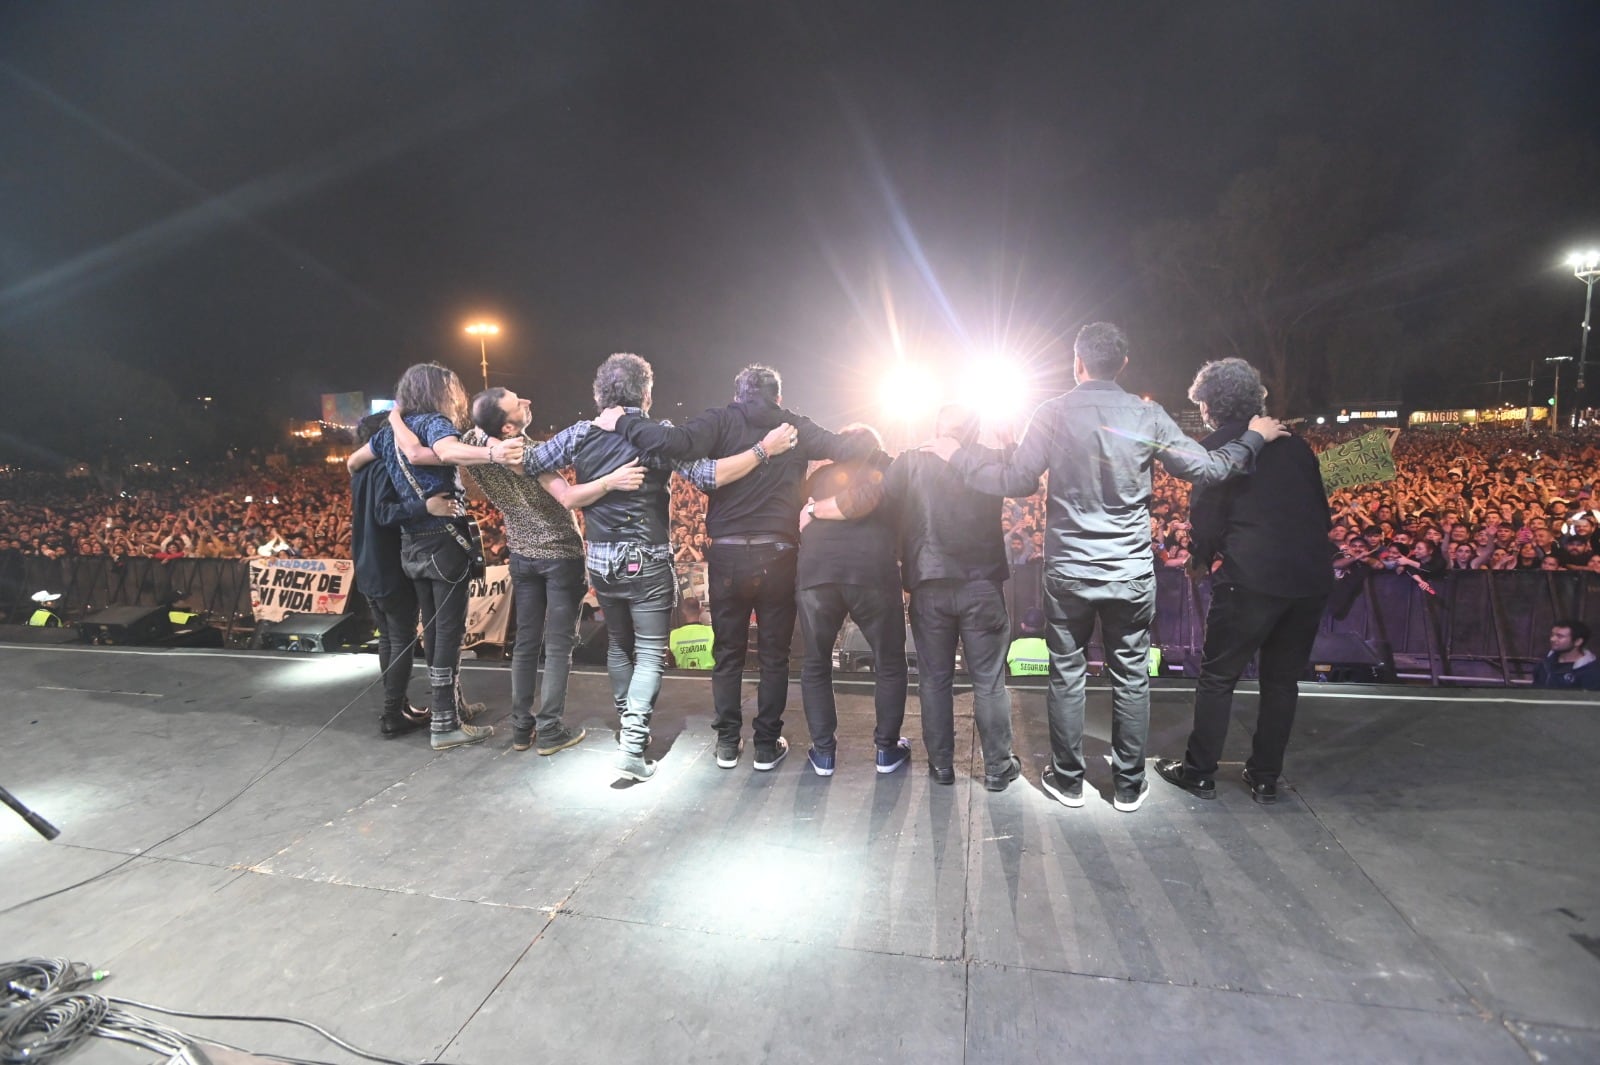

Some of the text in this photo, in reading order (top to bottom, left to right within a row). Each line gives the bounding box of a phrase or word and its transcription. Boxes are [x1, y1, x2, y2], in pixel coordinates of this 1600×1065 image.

[267, 559, 326, 571] MENDOZA
[272, 568, 317, 591] ROCK
[317, 574, 342, 594] DE
[260, 587, 313, 612] MI VIDA
